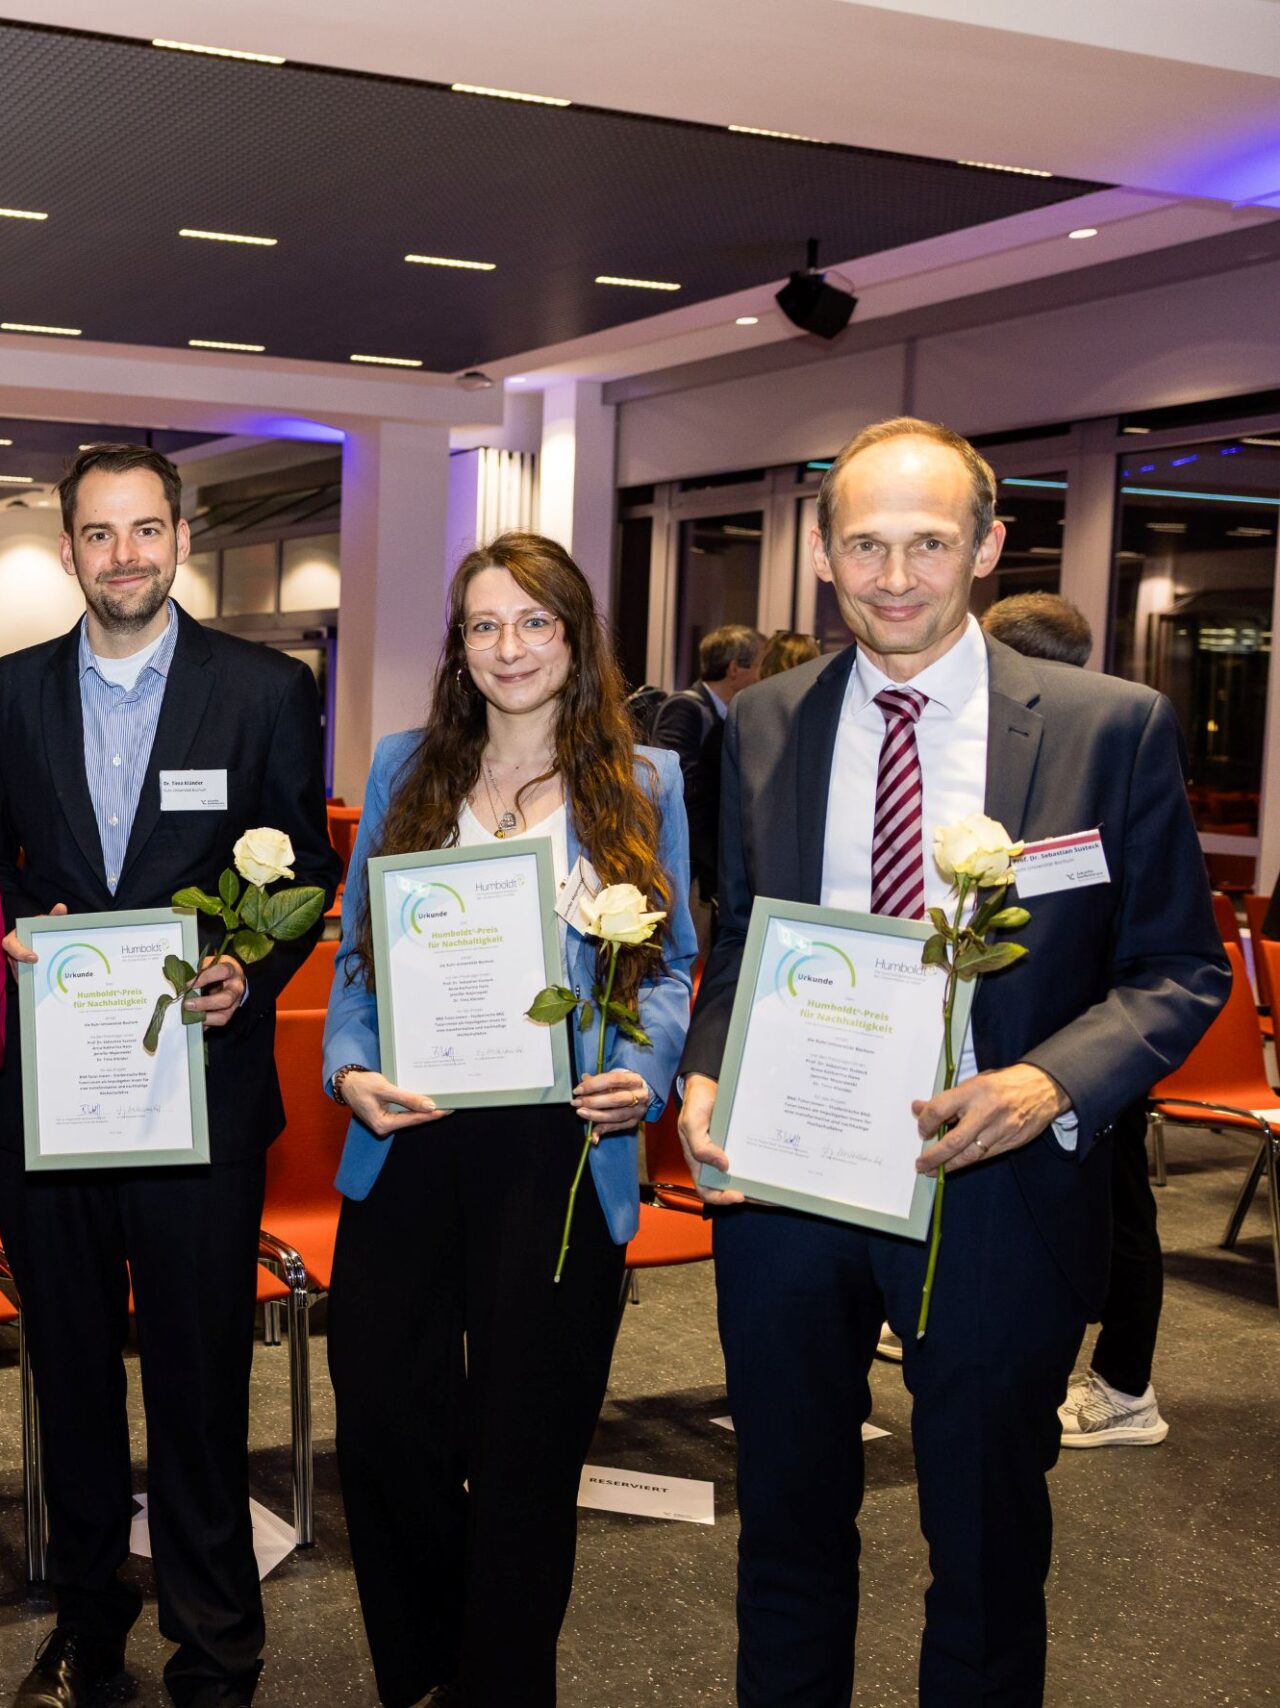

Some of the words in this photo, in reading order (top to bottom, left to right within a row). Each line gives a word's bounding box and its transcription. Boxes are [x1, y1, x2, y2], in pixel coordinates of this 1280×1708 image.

[1040, 849, 1073, 860] Sebastian
[1073, 843, 1100, 853] Susteck
[475, 879, 519, 892] Humboldt
[417, 910, 448, 920] Urkunde
[427, 940, 442, 949] für
[442, 935, 504, 949] Nachhaltigkeit
[121, 943, 163, 955] Humboldt
[874, 957, 928, 977] Humboldt
[64, 971, 94, 979] Urkunde
[797, 973, 834, 986] Urkunde
[73, 1000, 87, 1009] für
[87, 997, 148, 1009] Nachhaltigkeit
[799, 1009, 815, 1021] für
[816, 1012, 894, 1034] Nachhaltigkeit
[589, 1477, 670, 1493] RESERVIERT
